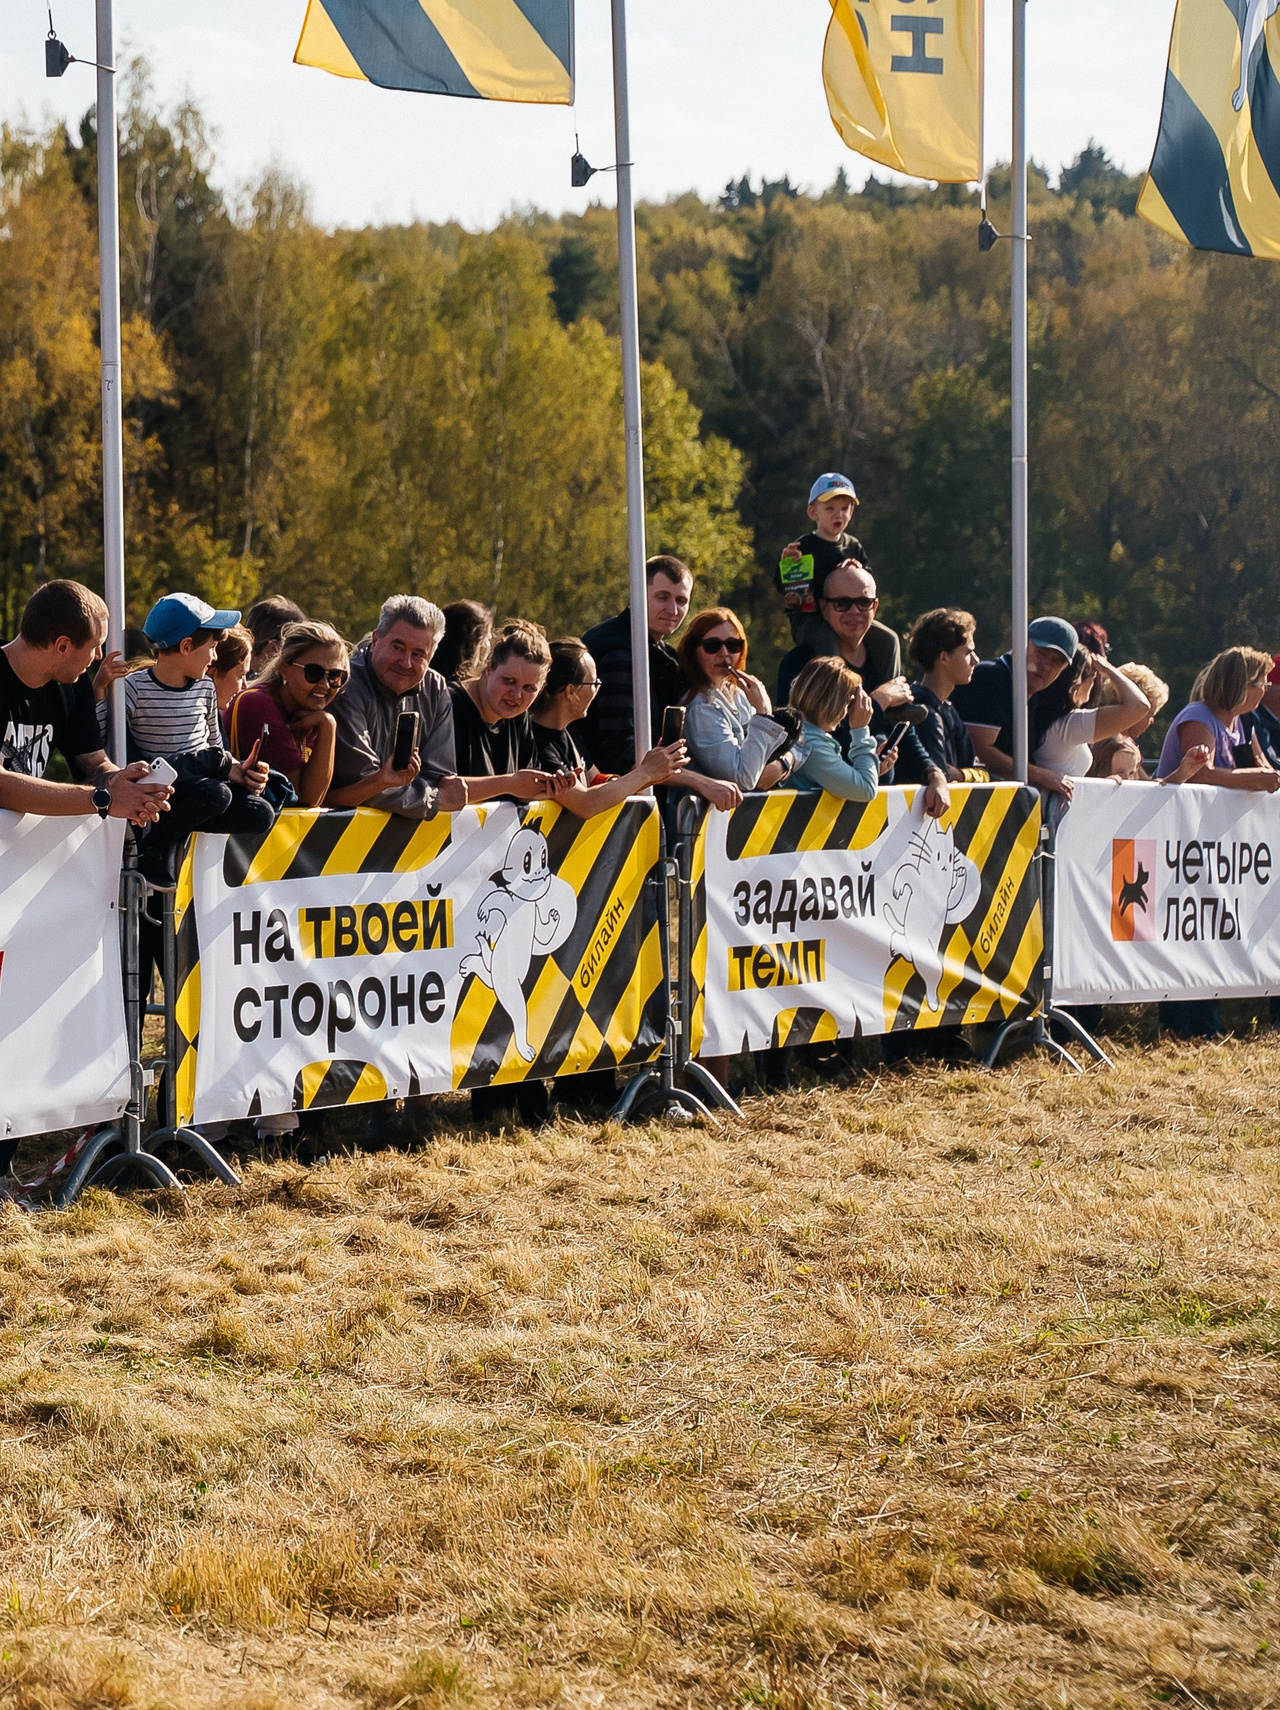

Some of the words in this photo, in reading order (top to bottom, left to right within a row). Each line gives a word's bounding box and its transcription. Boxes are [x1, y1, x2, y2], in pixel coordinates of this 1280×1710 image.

[232, 908, 295, 966] на
[305, 883, 449, 960] твоей
[733, 861, 876, 934] задавай
[981, 876, 1014, 954] билайн
[1163, 896, 1242, 942] лапы
[580, 897, 625, 988] билайн
[733, 941, 822, 990] темп
[233, 970, 446, 1053] стороне
